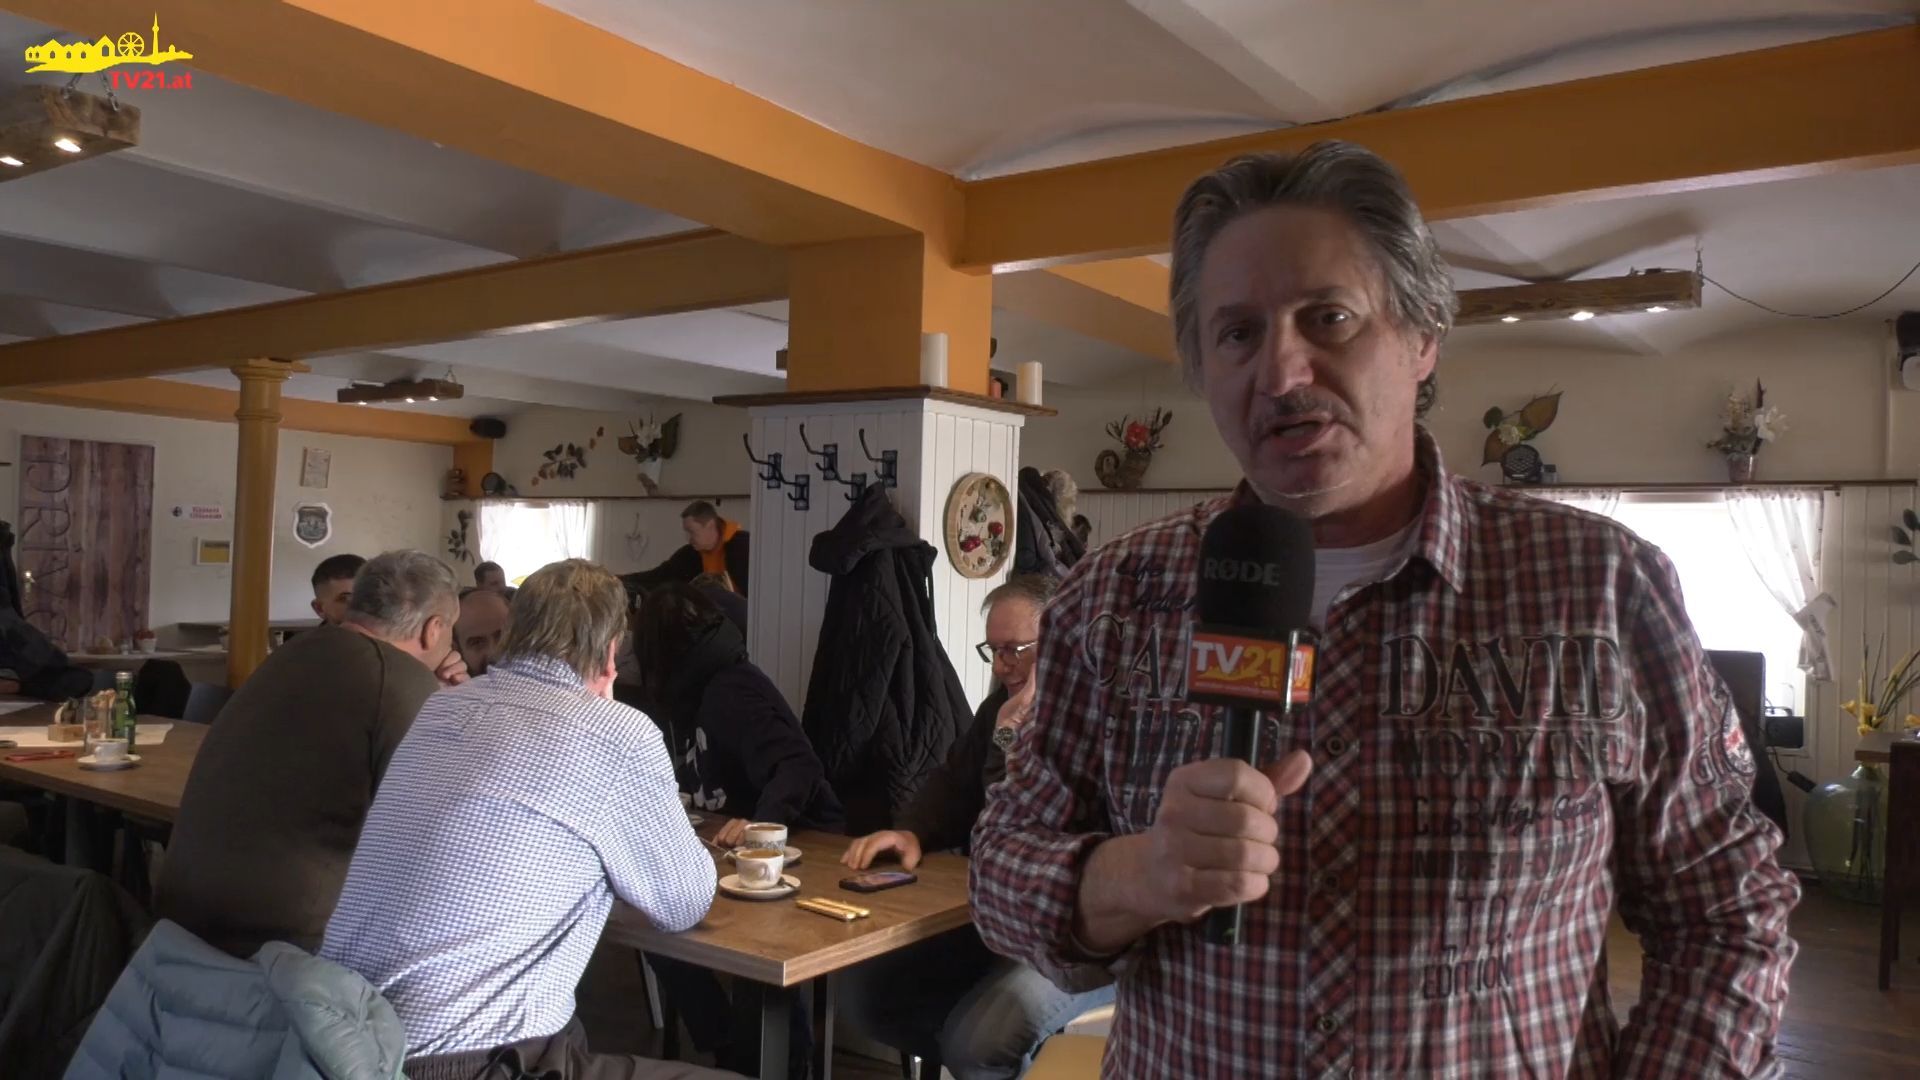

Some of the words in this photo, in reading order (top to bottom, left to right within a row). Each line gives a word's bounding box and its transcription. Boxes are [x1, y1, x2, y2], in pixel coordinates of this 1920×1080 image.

[1203, 557, 1281, 587] RØDE
[1084, 609, 1192, 702] CA
[1379, 633, 1626, 722] DAVID
[1191, 639, 1283, 677] TV21
[1422, 952, 1513, 1000] EDITION
